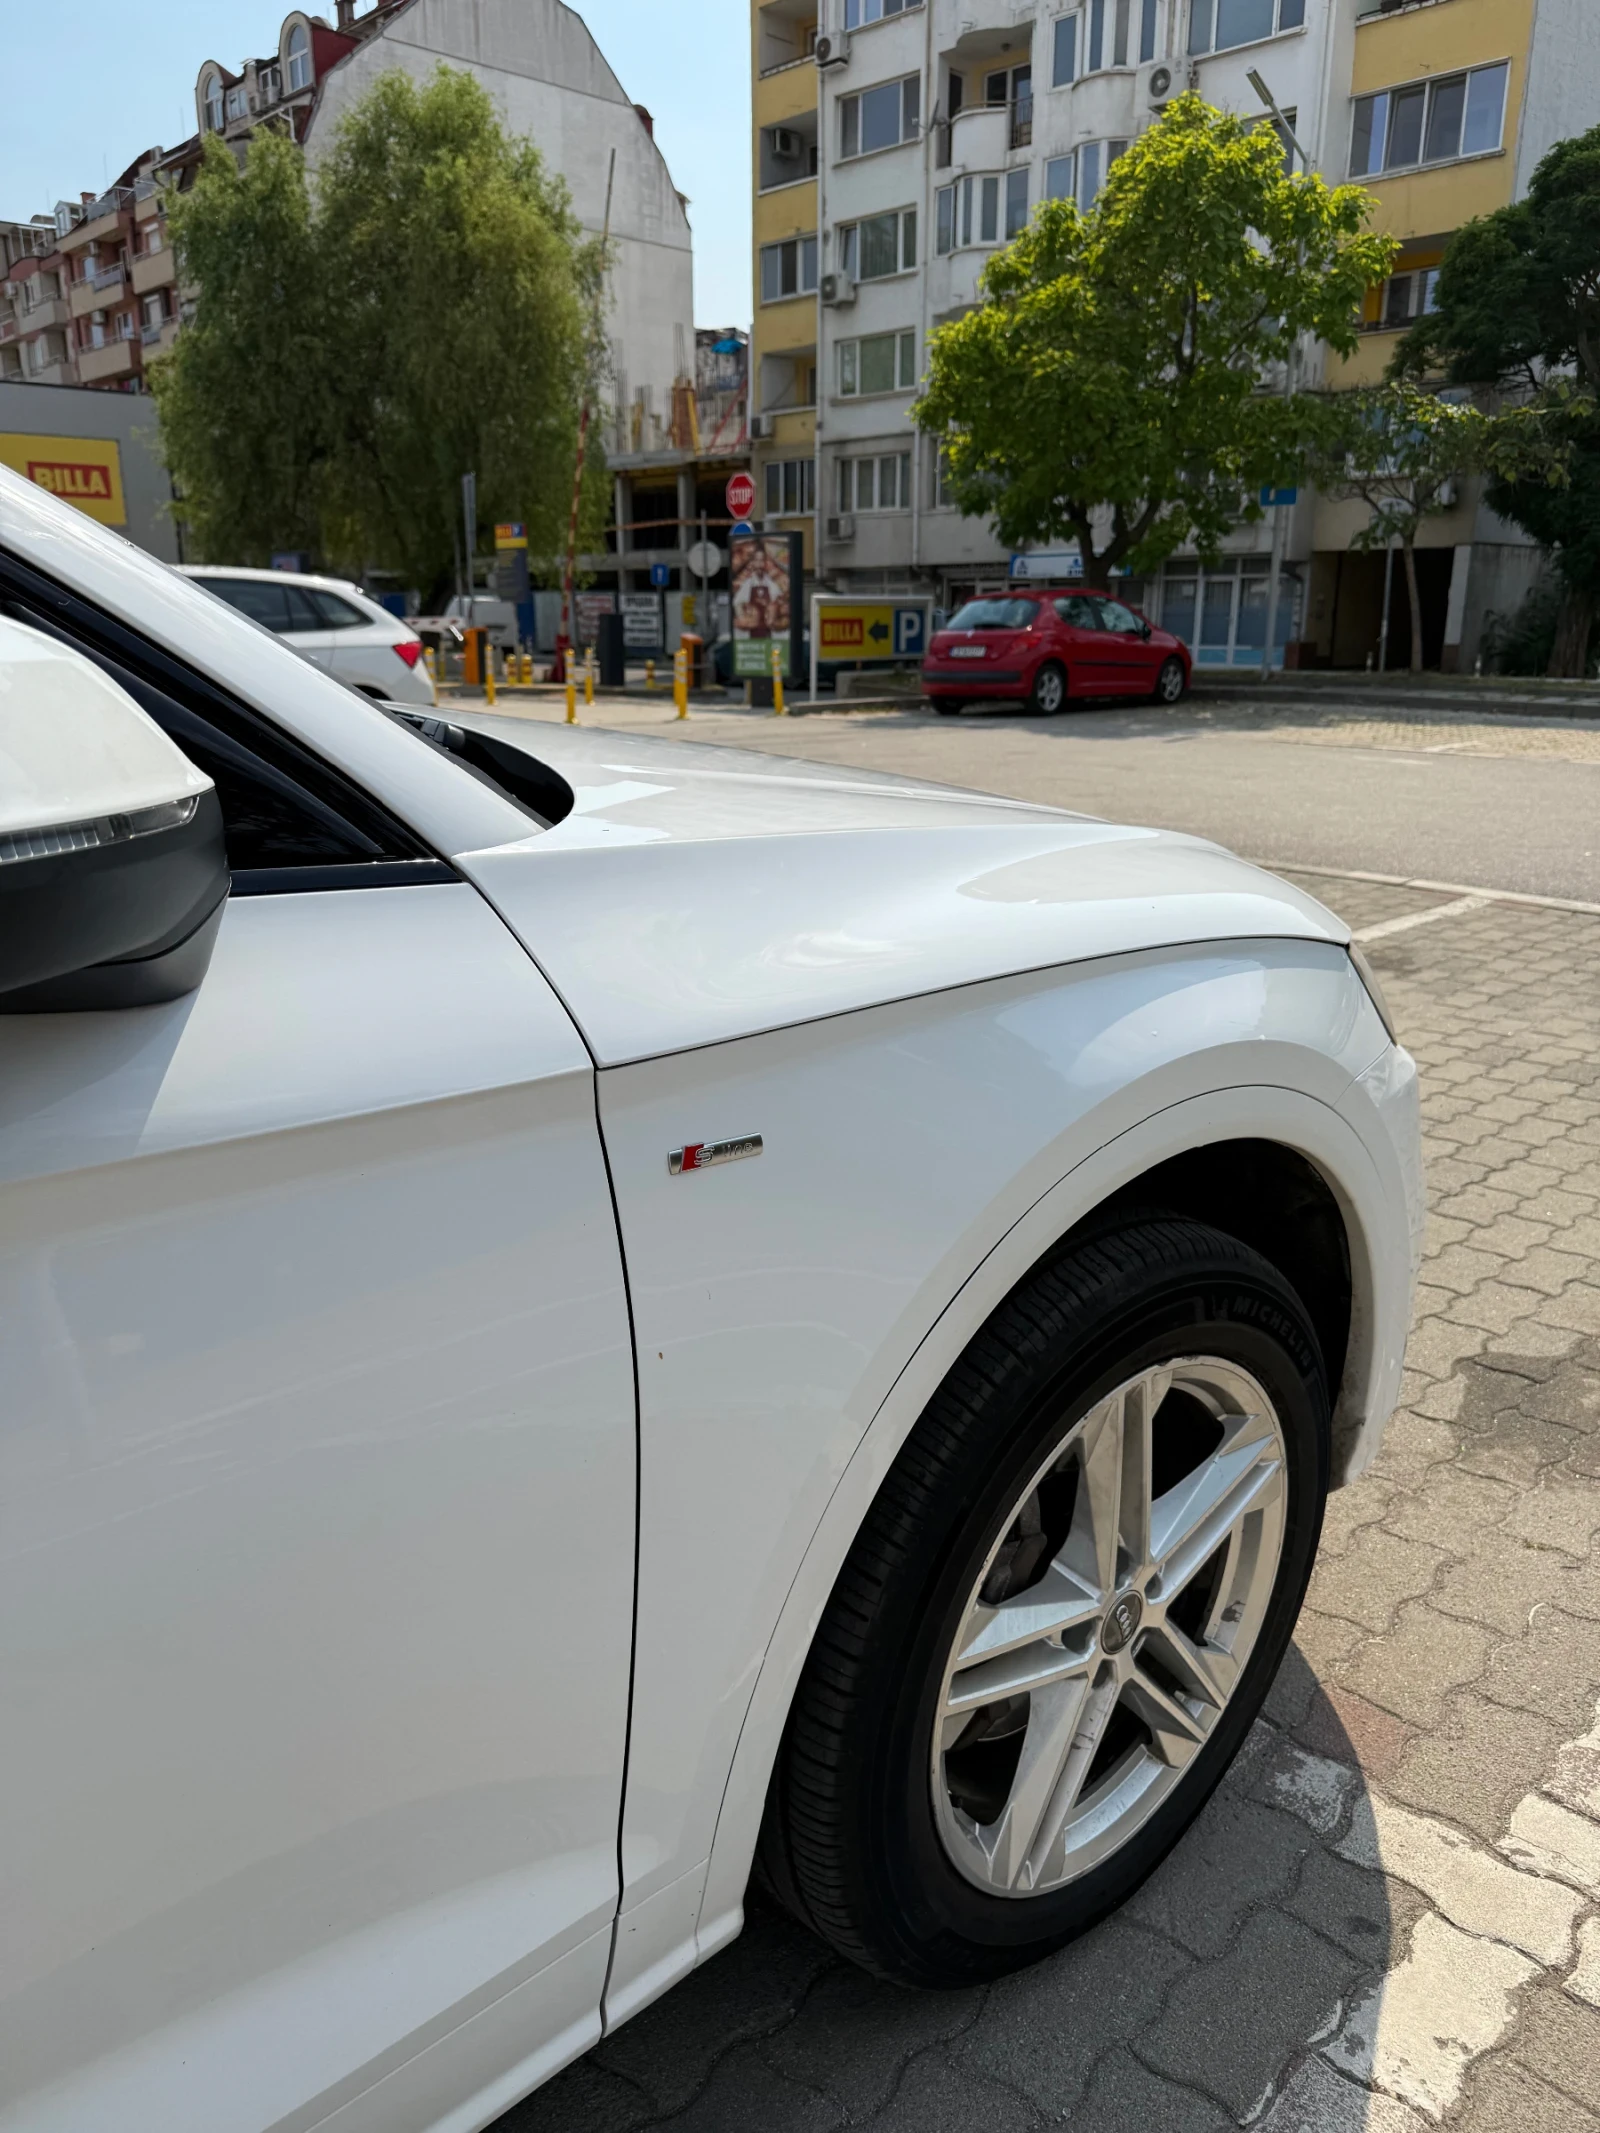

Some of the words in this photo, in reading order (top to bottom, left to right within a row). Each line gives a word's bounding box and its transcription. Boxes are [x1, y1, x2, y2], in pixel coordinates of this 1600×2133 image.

[34, 466, 108, 495] BILLA
[729, 487, 753, 505] STOP
[823, 622, 861, 642] BILLA
[899, 611, 921, 653] P
[694, 1145, 716, 1166] S
[723, 1142, 754, 1157] line
[1232, 1295, 1312, 1367] MICHELIN
